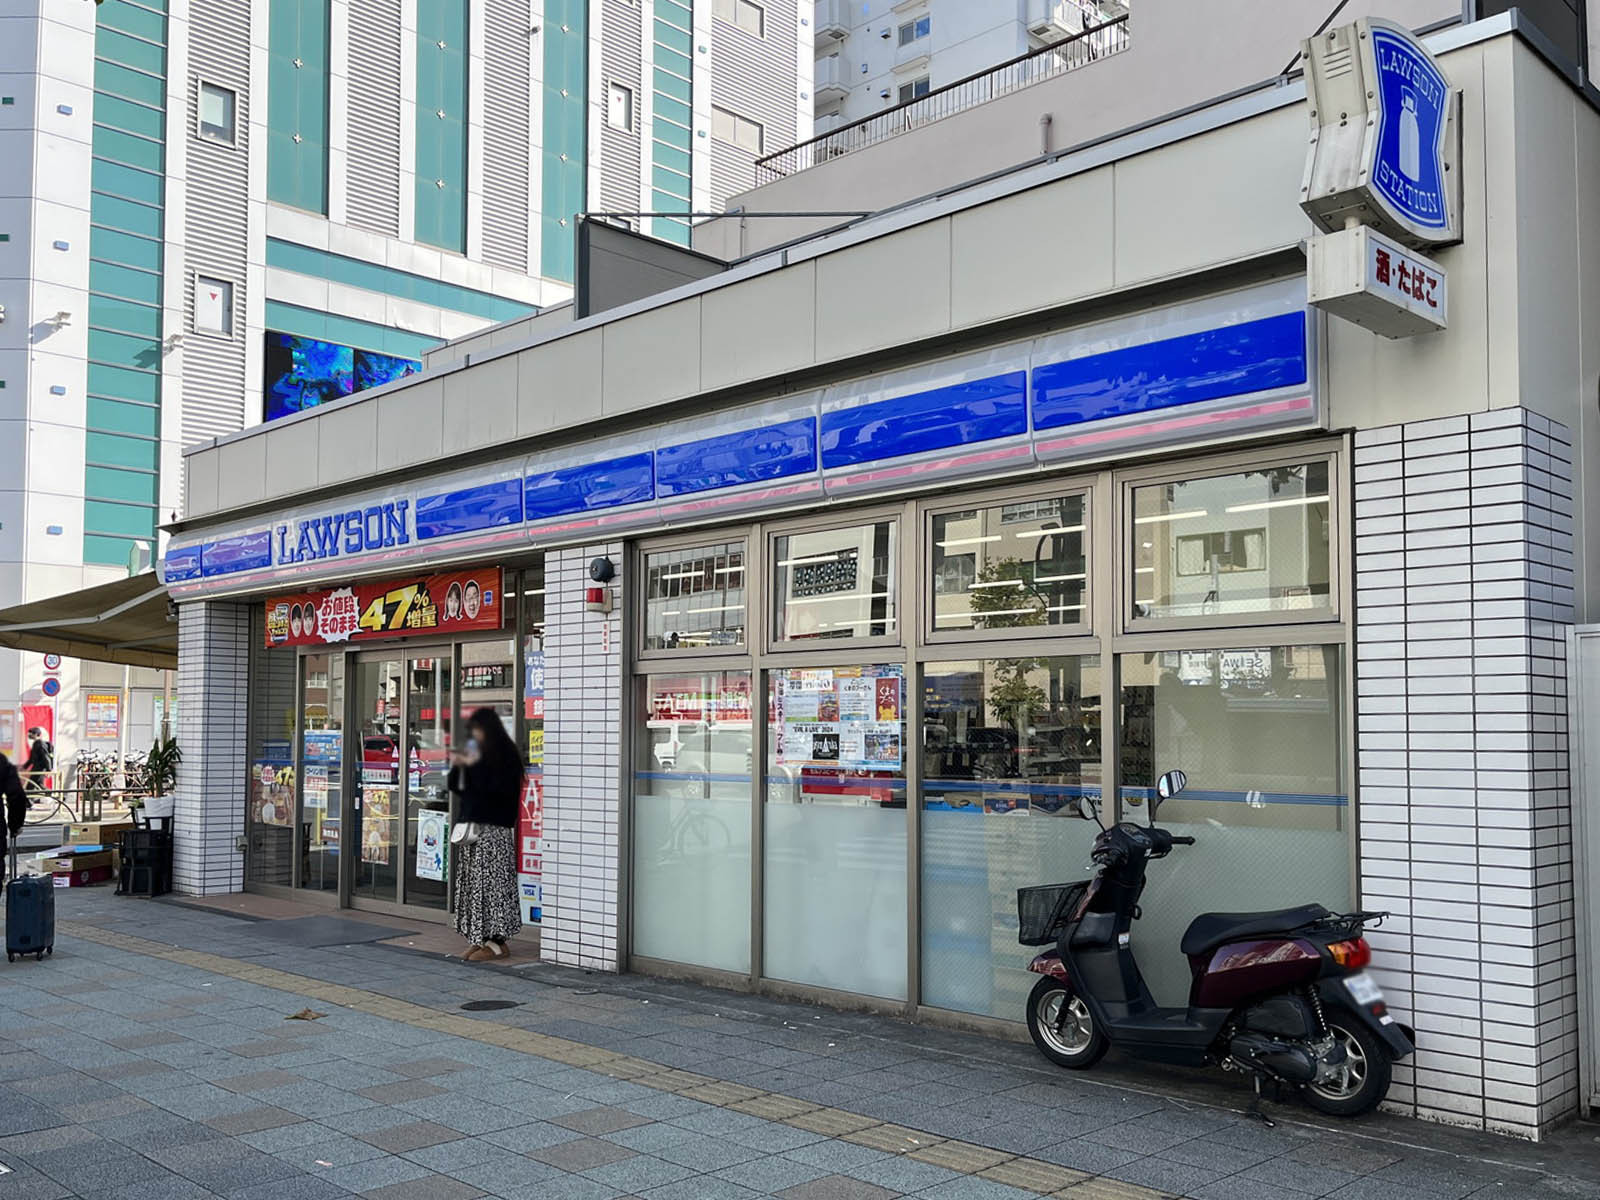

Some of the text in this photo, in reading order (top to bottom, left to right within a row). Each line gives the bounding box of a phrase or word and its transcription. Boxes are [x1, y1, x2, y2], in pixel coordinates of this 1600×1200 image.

[1380, 48, 1439, 109] LAWSON
[1380, 160, 1438, 213] STATION
[277, 499, 409, 566] LAWSON
[321, 595, 355, 617] お値段
[321, 615, 356, 634] そのまま
[407, 605, 437, 628] 増量
